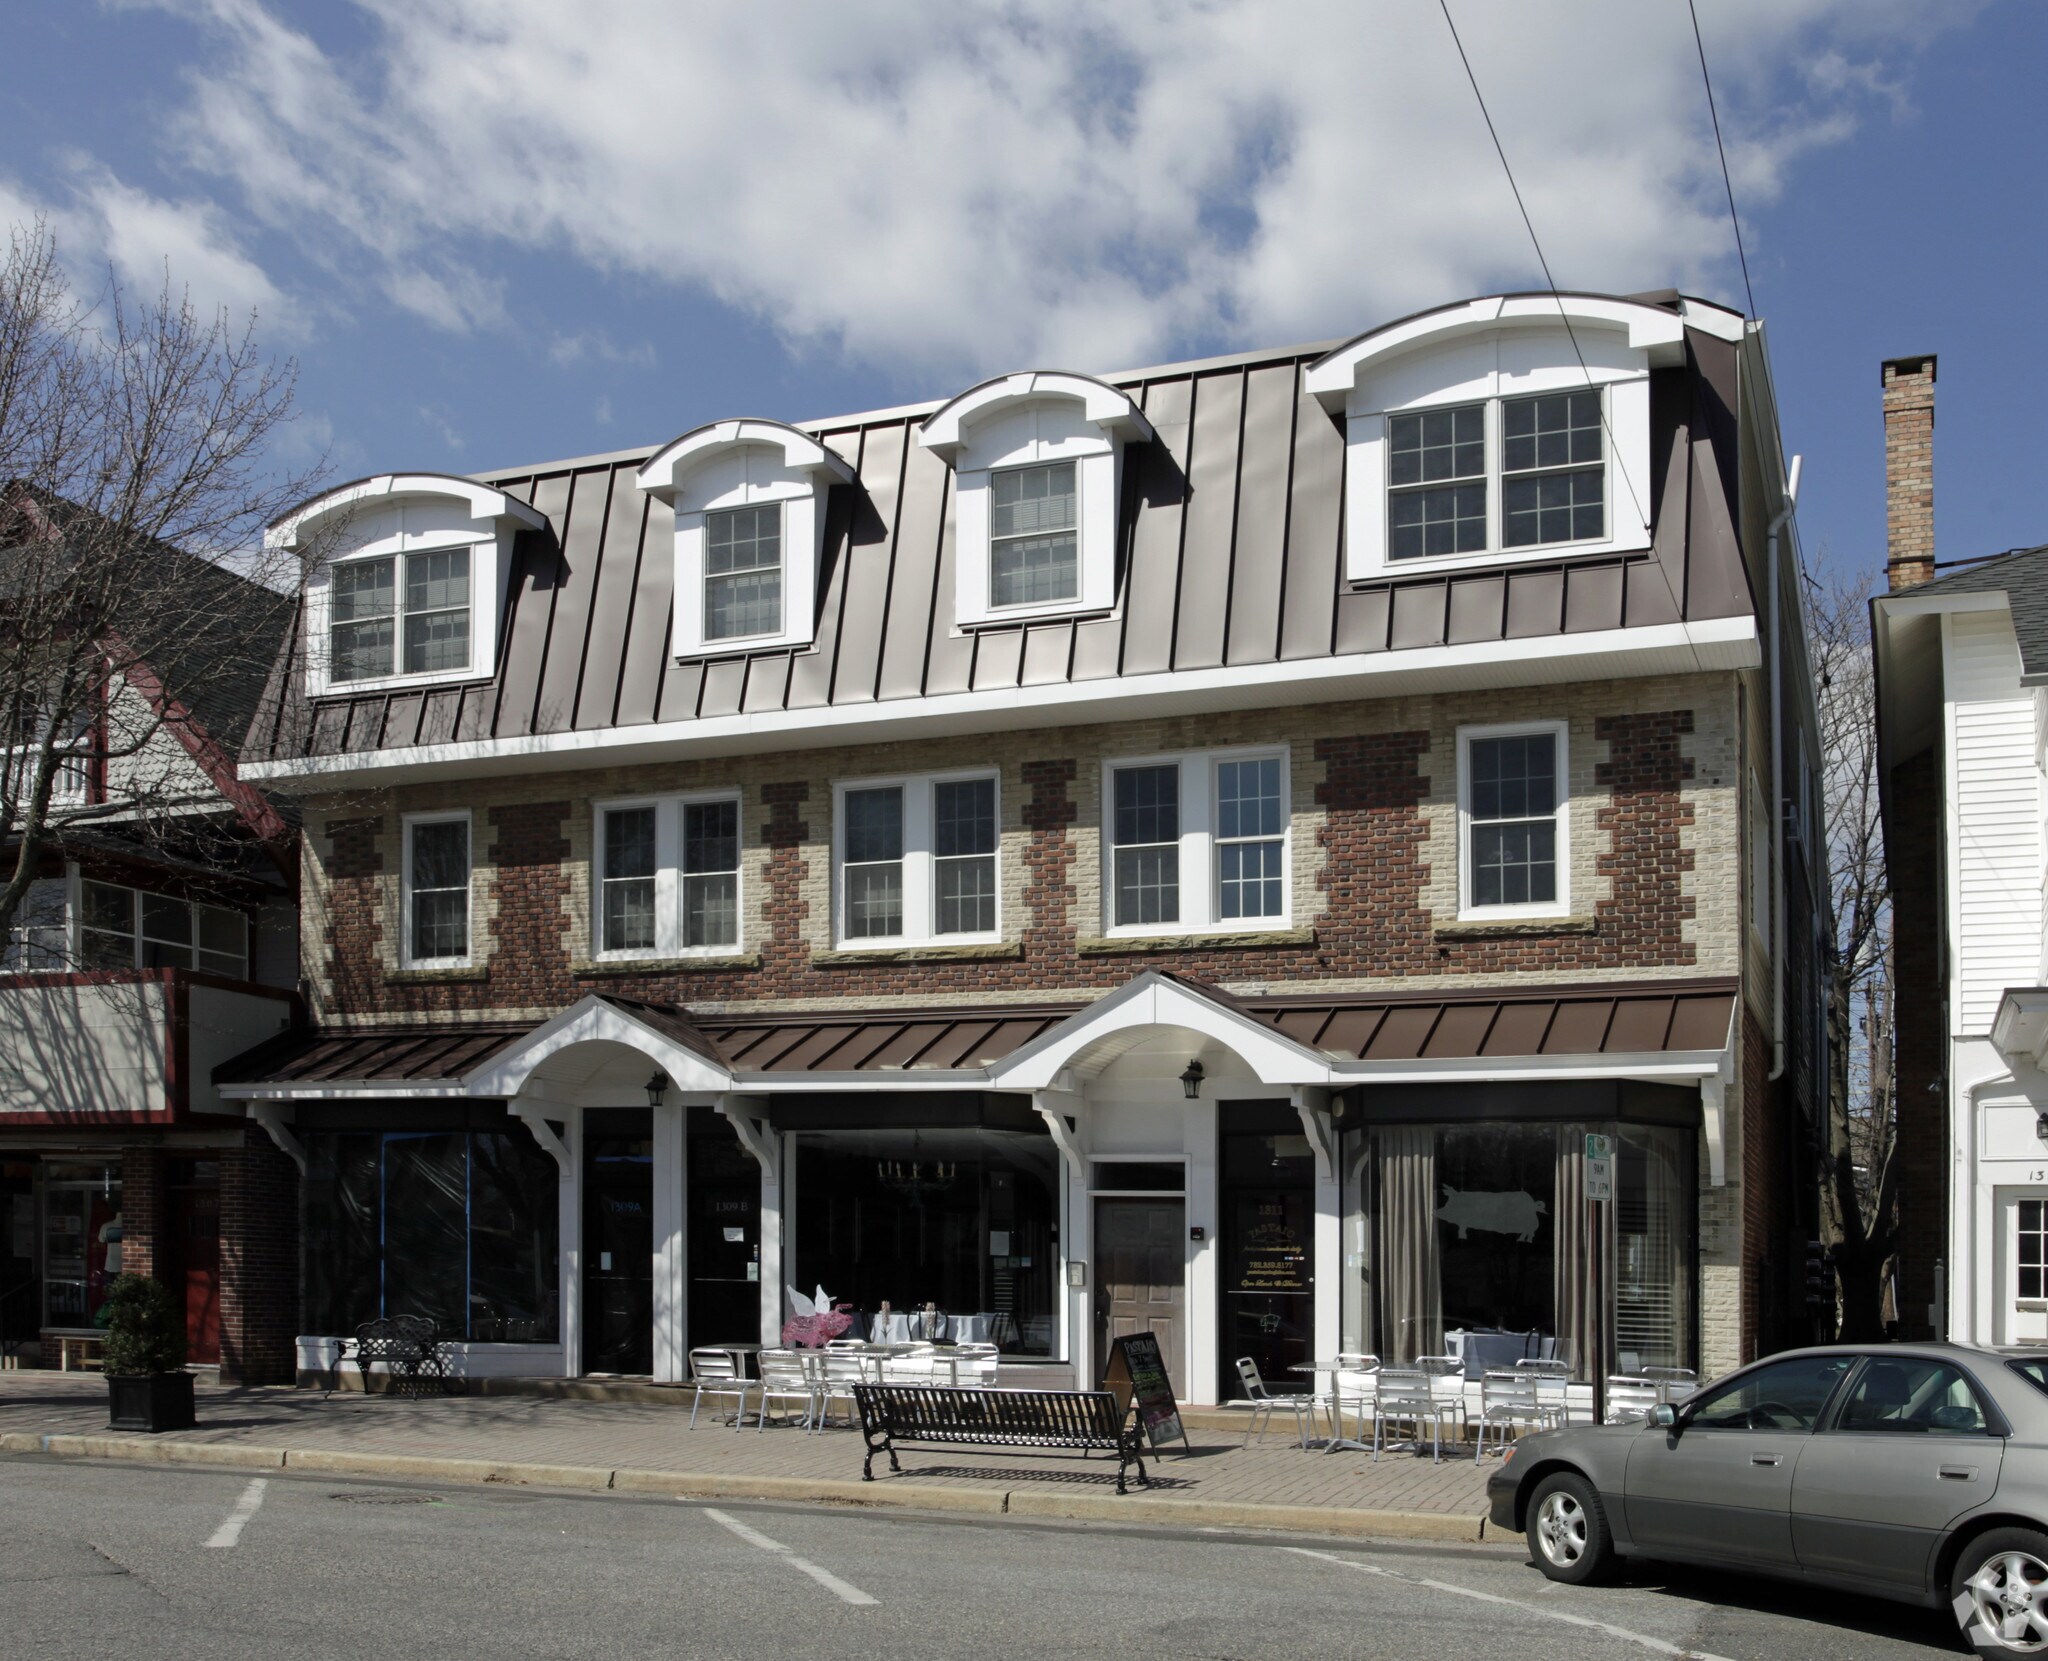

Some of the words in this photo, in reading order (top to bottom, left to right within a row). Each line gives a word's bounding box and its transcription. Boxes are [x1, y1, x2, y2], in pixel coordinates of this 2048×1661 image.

[1589, 1139, 1594, 1156] 2
[1594, 1163, 1604, 1175] 9AM
[1589, 1181, 1596, 1194] TO
[1598, 1182, 1609, 1194] 6PM
